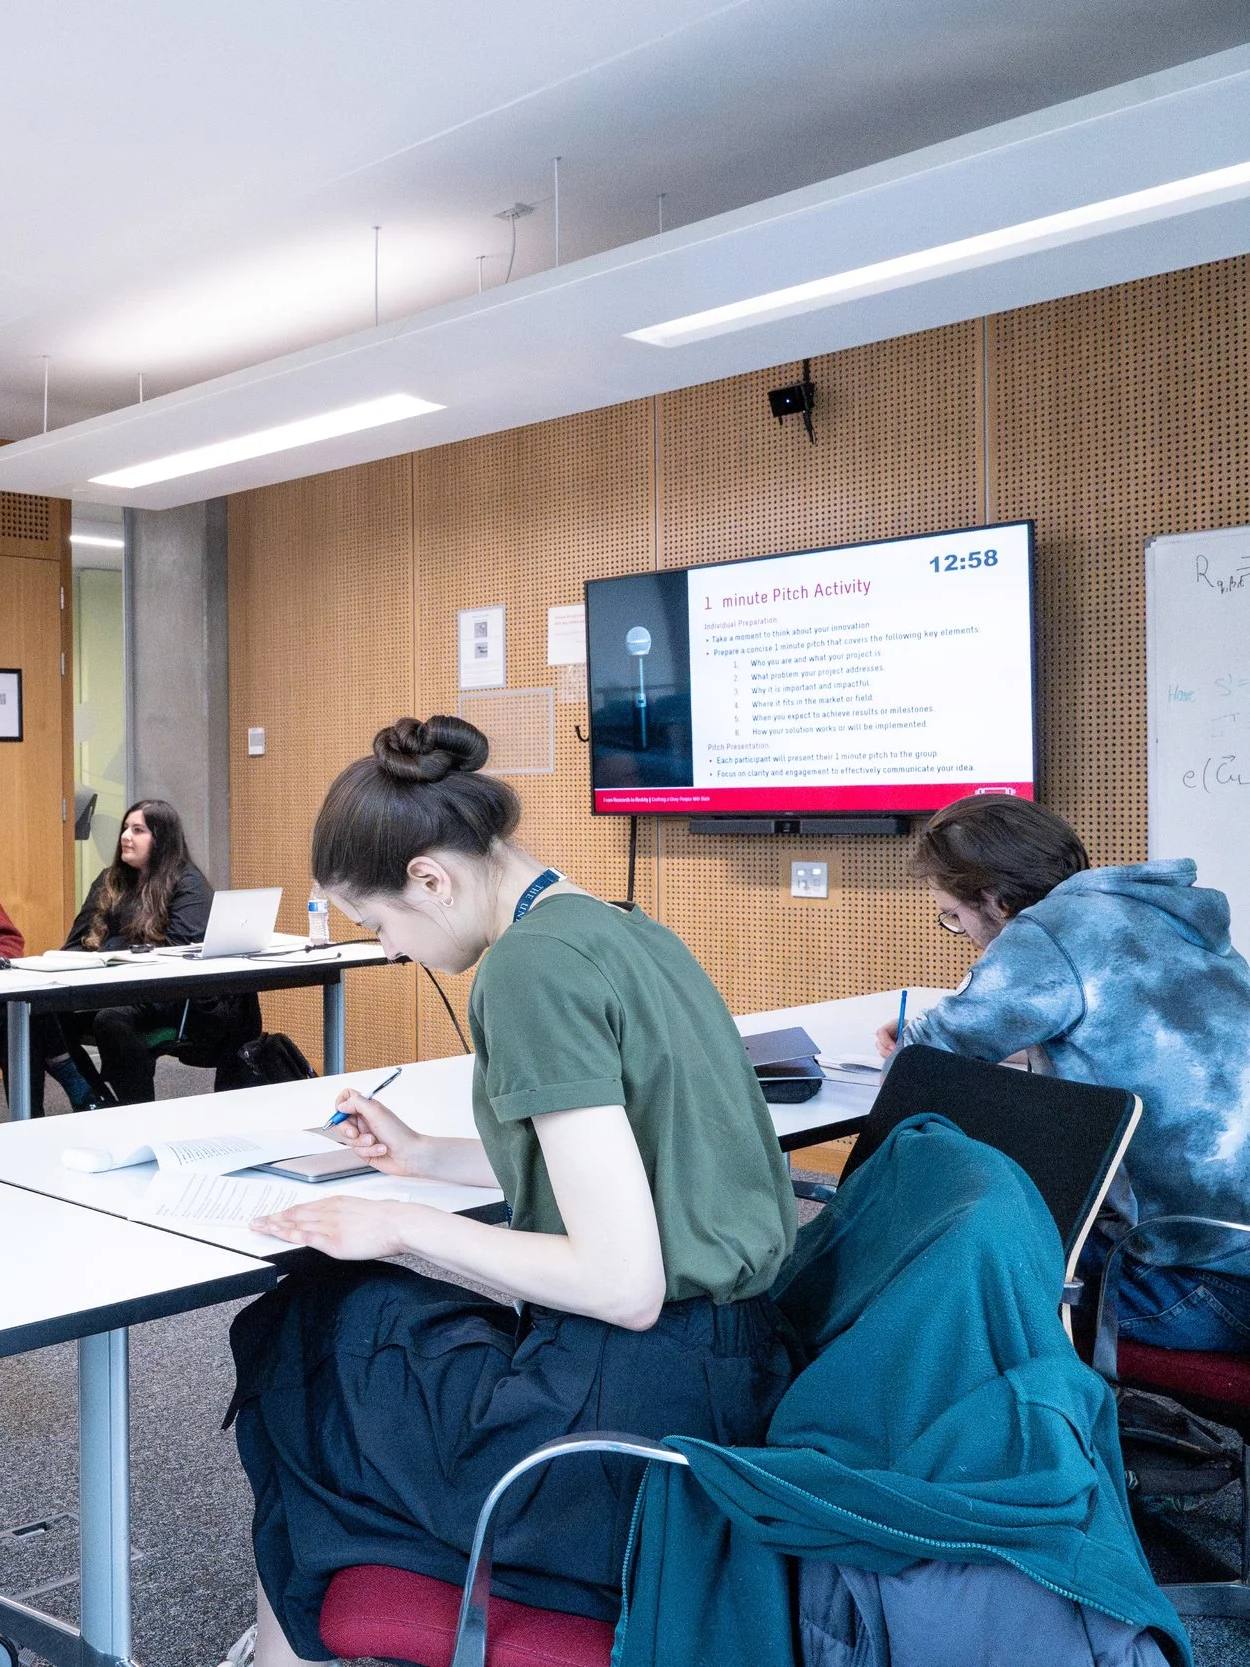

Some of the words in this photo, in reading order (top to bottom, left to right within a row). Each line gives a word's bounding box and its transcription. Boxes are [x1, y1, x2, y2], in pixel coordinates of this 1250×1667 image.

[929, 549, 999, 573] 12:58
[704, 597, 712, 610] 1
[722, 592, 768, 608] minute
[773, 585, 808, 603] Pitch
[814, 578, 872, 598] Activity
[704, 621, 737, 630] Individual
[712, 635, 727, 643] Take
[734, 633, 762, 641] moment
[772, 628, 790, 637] think
[792, 627, 812, 636] about
[814, 626, 829, 635] your
[831, 621, 870, 632] innovation
[713, 648, 739, 657] Prepare
[746, 645, 772, 654] concise
[774, 643, 779, 651] 1
[780, 641, 805, 650] minute
[806, 639, 826, 650] pitch
[827, 638, 842, 646] that
[844, 636, 868, 645] covers
[885, 630, 922, 641] following
[924, 629, 938, 638] key
[750, 659, 766, 667] Who
[767, 659, 780, 668] you
[809, 654, 827, 662] what
[828, 652, 844, 662] your
[846, 650, 873, 660] project
[751, 672, 769, 681] What
[770, 671, 799, 681] problem
[801, 669, 816, 678] your
[818, 667, 844, 677] project
[751, 686, 767, 695] Why
[767, 684, 773, 693] it
[782, 682, 817, 693] important
[752, 700, 774, 708] Where
[775, 699, 781, 707] it
[782, 698, 794, 707] fits
[796, 698, 803, 706] in
[804, 697, 816, 705] the
[818, 695, 844, 704] market
[752, 714, 772, 722] When
[773, 714, 786, 723] you
[787, 711, 811, 721] expect
[812, 711, 821, 719] to
[821, 709, 851, 718] achieve
[852, 707, 879, 717] results
[752, 728, 768, 736] How
[768, 728, 784, 737] your
[785, 725, 814, 735] solution
[815, 725, 837, 733] works
[847, 723, 862, 731] will
[863, 723, 873, 731] be
[707, 743, 725, 751] Pitch
[716, 756, 733, 764] Each
[734, 755, 771, 765] participant
[773, 755, 786, 763] will
[787, 754, 814, 764] present
[815, 753, 834, 761] their
[835, 752, 839, 760] 1
[841, 751, 867, 760] minute
[868, 751, 888, 760] pitch
[900, 750, 913, 758] the
[717, 769, 737, 778] Focus
[747, 767, 769, 778] clarity
[770, 768, 783, 776] and
[785, 767, 829, 778] engagement
[831, 767, 839, 775] to
[840, 765, 881, 776] effectively
[882, 765, 935, 774] communicate
[936, 765, 954, 774] your
[525, 884, 544, 900] THE
